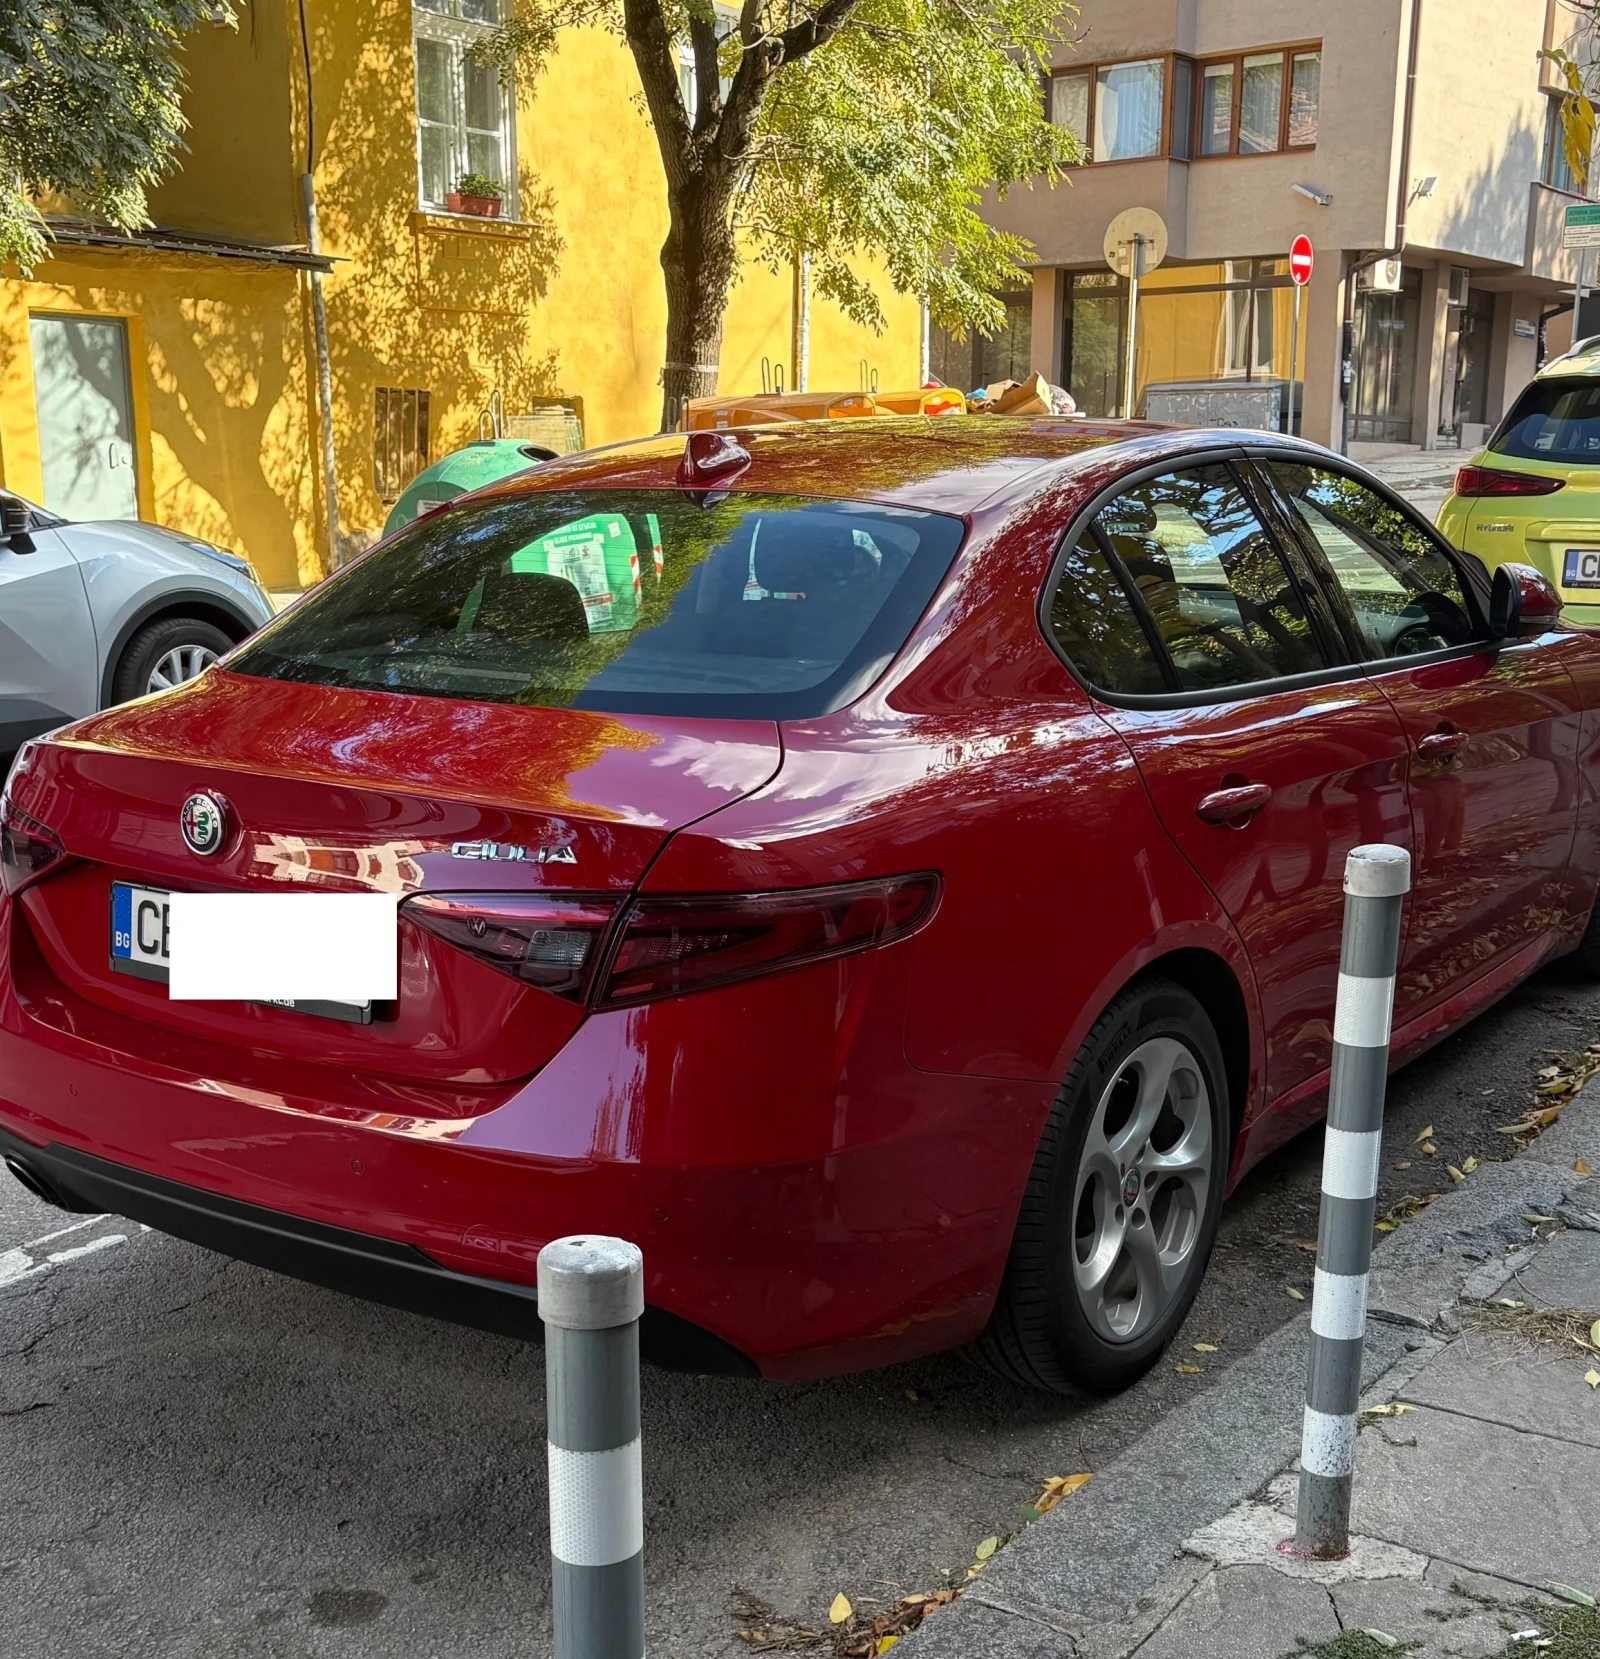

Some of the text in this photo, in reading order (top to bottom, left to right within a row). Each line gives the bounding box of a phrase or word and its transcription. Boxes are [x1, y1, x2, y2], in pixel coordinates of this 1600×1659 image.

[1476, 523, 1514, 533] HYUNDAI
[1565, 569, 1576, 578] BG
[1581, 554, 1600, 579] C
[197, 798, 218, 828] ROMEO
[452, 841, 578, 864] GIULIA
[115, 930, 130, 949] BG
